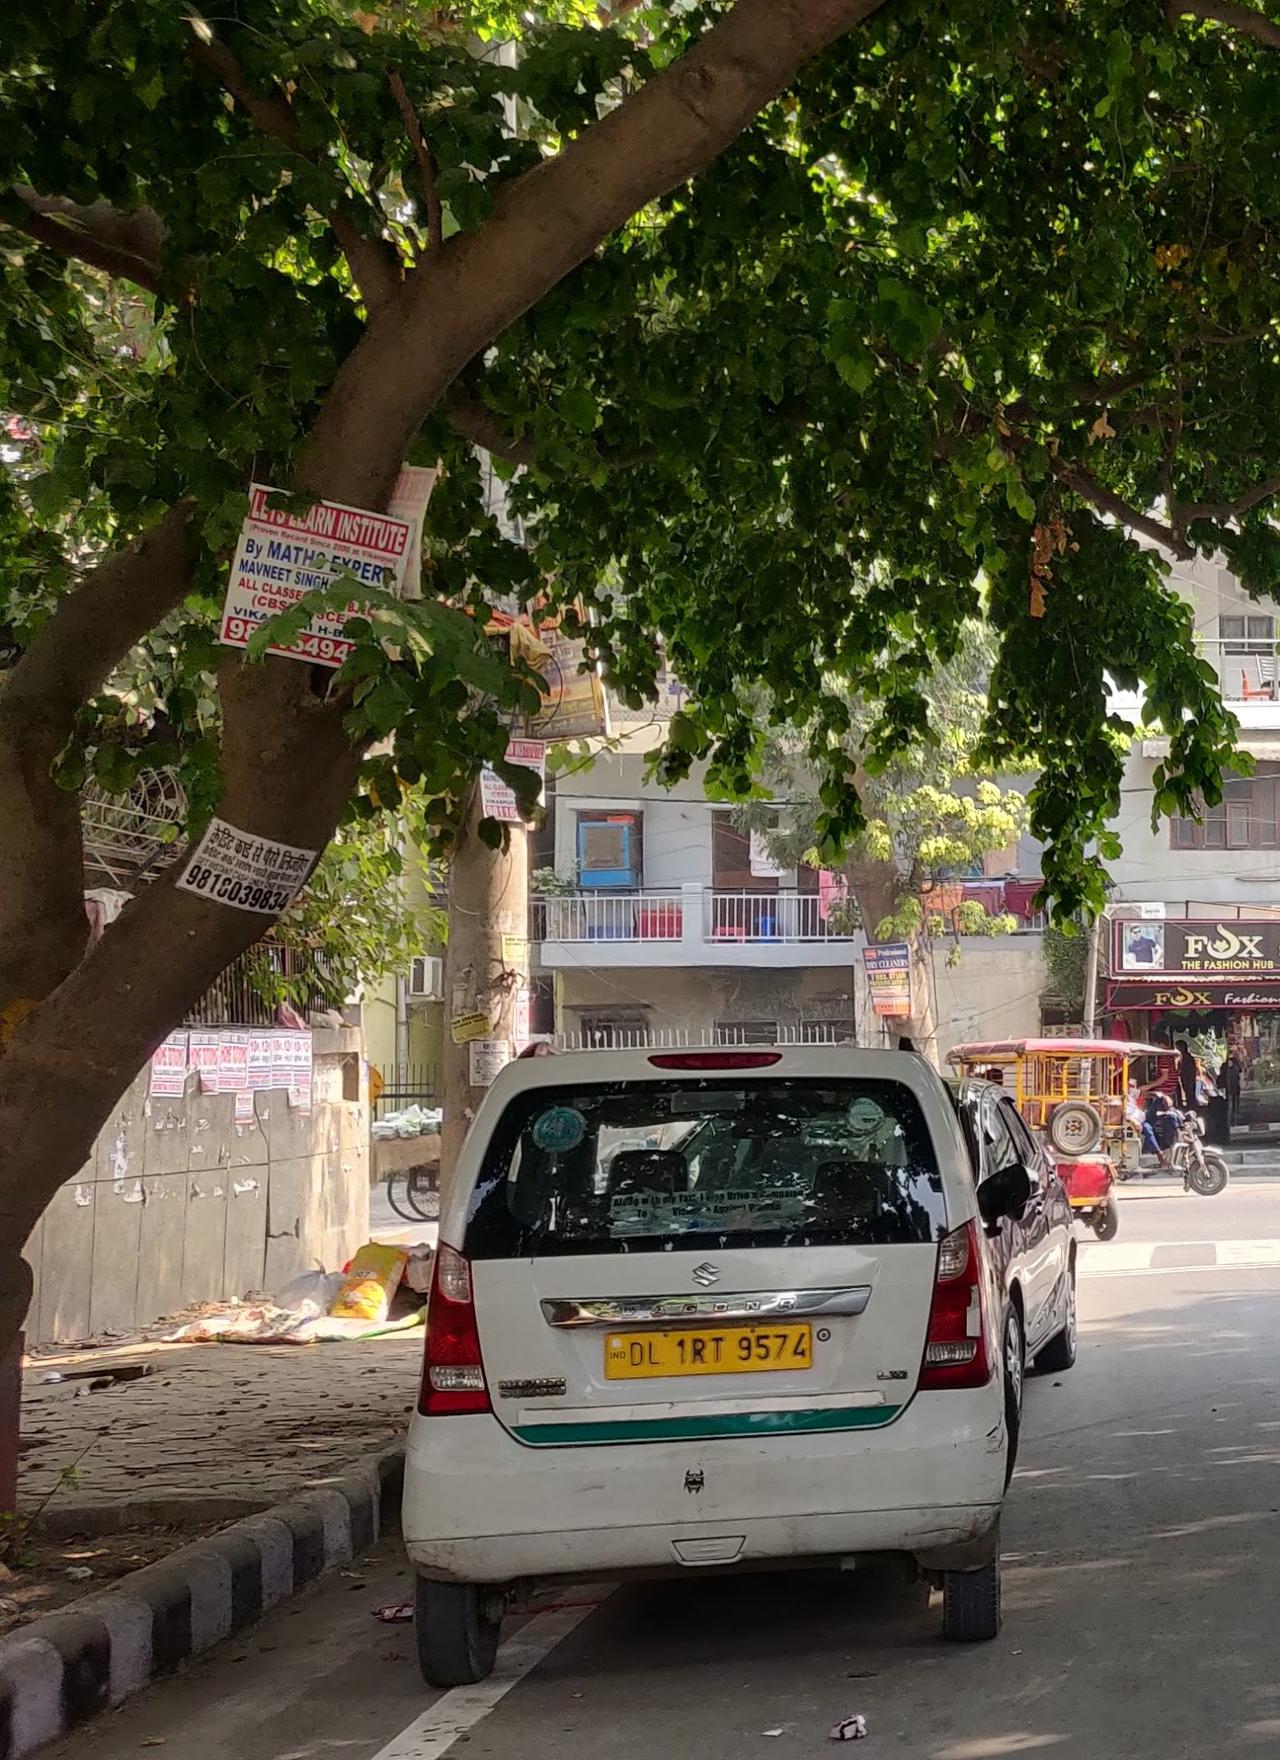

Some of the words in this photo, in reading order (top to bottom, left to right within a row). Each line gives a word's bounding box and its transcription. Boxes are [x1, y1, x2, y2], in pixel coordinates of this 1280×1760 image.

[336, 510, 407, 554] INSTITUTE
[238, 559, 292, 583] MAVNEET
[295, 570, 330, 590] SINGH
[245, 539, 263, 554] By
[330, 555, 388, 584] EXPER
[238, 577, 258, 591] ALL
[261, 582, 304, 601] CLASSE
[252, 594, 291, 612] (CBS
[1184, 923, 1264, 960] FOX
[1181, 960, 1203, 970] THE
[1203, 960, 1250, 970] FASHION
[1252, 960, 1274, 970] HUB
[1153, 986, 1212, 1006] FOX
[620, 1300, 761, 1316] WAGON
[776, 1294, 798, 1312] R
[629, 1341, 661, 1367] DL
[677, 1336, 725, 1364] 1RT
[738, 1333, 808, 1362] 9574
